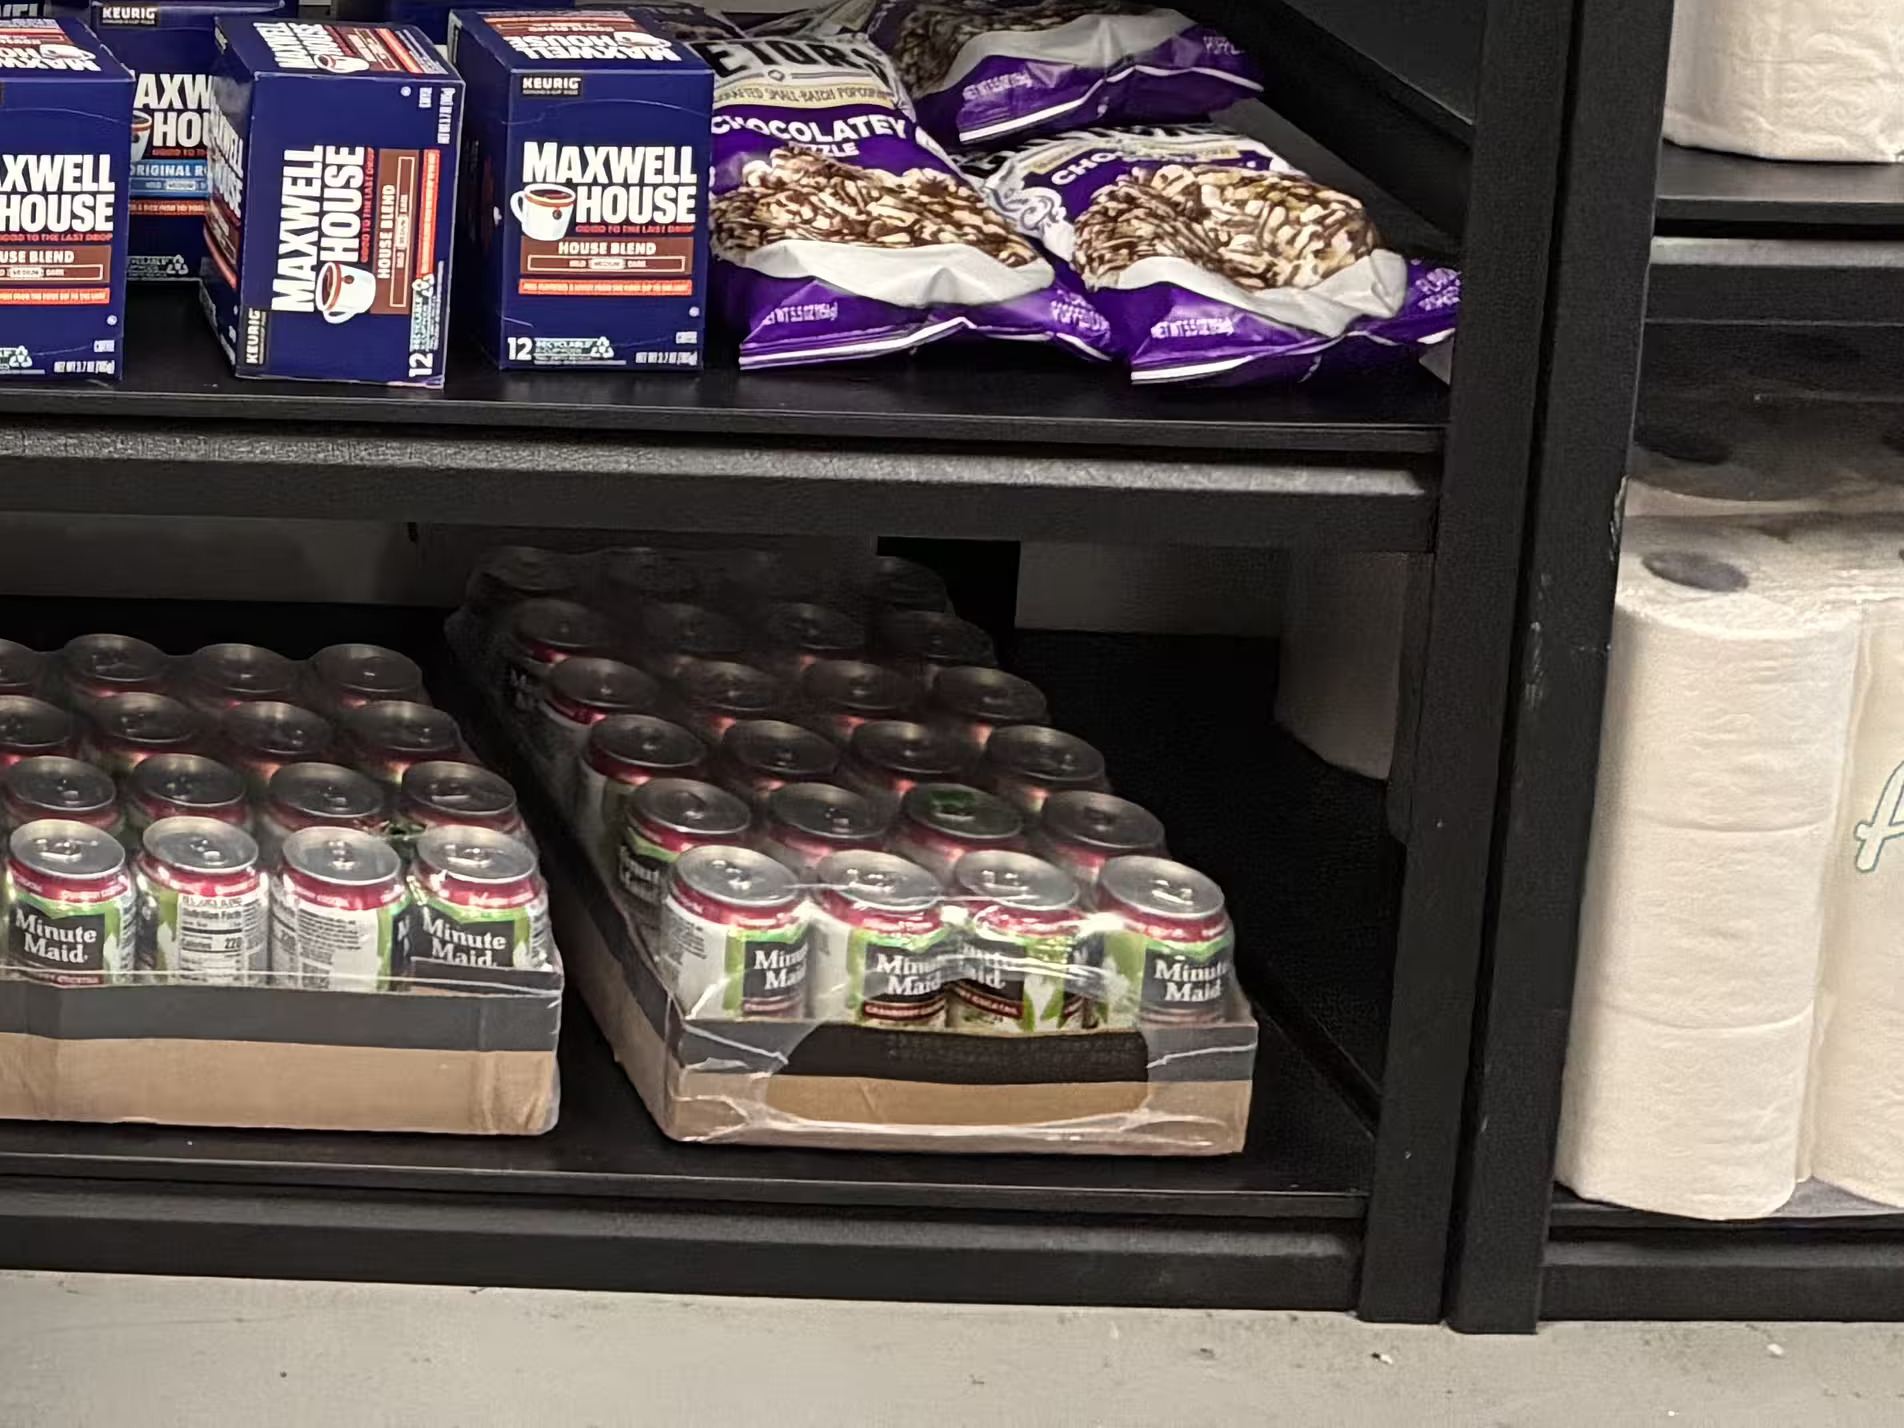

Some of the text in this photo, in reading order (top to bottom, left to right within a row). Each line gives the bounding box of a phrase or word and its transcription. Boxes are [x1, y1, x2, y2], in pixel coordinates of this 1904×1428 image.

[523, 141, 697, 184] MAXWELL
[319, 146, 365, 248] HOUSE
[575, 185, 696, 223] HOUSE
[272, 145, 324, 313] MAXWELL
[15, 908, 98, 944] Minute
